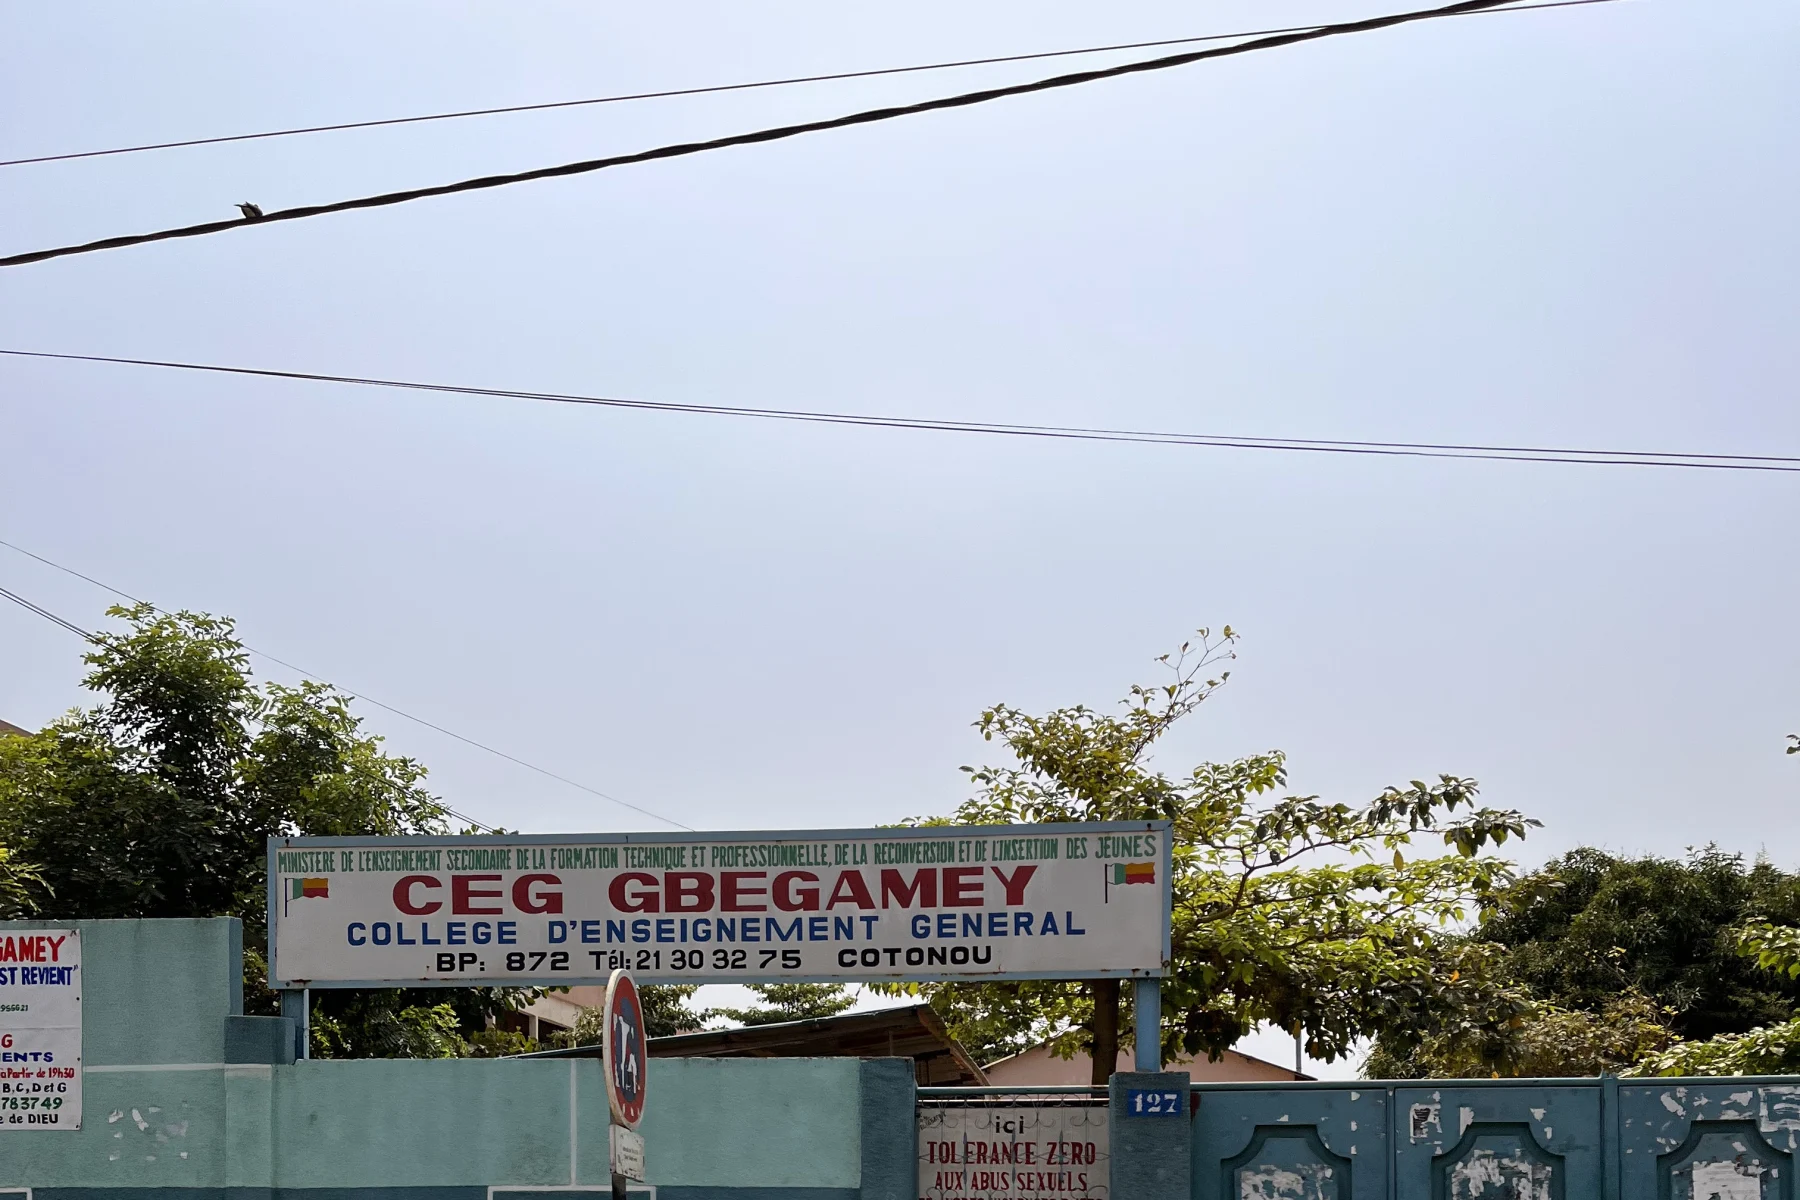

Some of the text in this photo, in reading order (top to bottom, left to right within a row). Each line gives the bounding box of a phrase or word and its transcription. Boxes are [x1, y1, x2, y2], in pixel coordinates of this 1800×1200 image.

[278, 851, 335, 873] MINISTERE
[341, 851, 354, 872] DE
[358, 850, 442, 872] L'ENSEIGNEMENT
[446, 848, 511, 871] SECONDAIRE
[516, 848, 529, 870] DE
[533, 848, 546, 870] LA
[551, 847, 619, 870] FORMATION
[623, 846, 687, 871] TECHNIQUE
[691, 846, 706, 868] ET
[834, 843, 849, 866] DE
[853, 843, 868, 865] LA
[874, 840, 955, 865] RECONVERSION
[958, 840, 972, 863] ET
[975, 840, 987, 862] DE
[1066, 837, 1088, 860] DES
[1095, 834, 1157, 859] JEUNES
[392, 865, 1039, 916] CEG GBEGAMEY
[347, 910, 1086, 947] COLLEGE D'ENSEIGNEMENT GENERAL
[0, 936, 66, 962] AMEY
[436, 952, 486, 973] BP:
[505, 951, 570, 972] 872
[636, 950, 660, 971] 21
[670, 949, 704, 971] 30
[712, 949, 747, 970] 32
[758, 949, 802, 970] 75
[837, 946, 992, 968] COTONOU
[36, 1067, 46, 1079] de
[48, 1066, 75, 1079] 19h30
[44, 1082, 54, 1093] et
[57, 1082, 67, 1093] G
[1134, 1093, 1178, 1113] 127
[9, 1113, 23, 1125] de
[28, 1113, 59, 1125] DIEU
[995, 1115, 1024, 1134] ici
[927, 1141, 1096, 1165] TOLERANCE ZERO
[934, 1171, 1088, 1191] AUX ABUS SEXUELS
